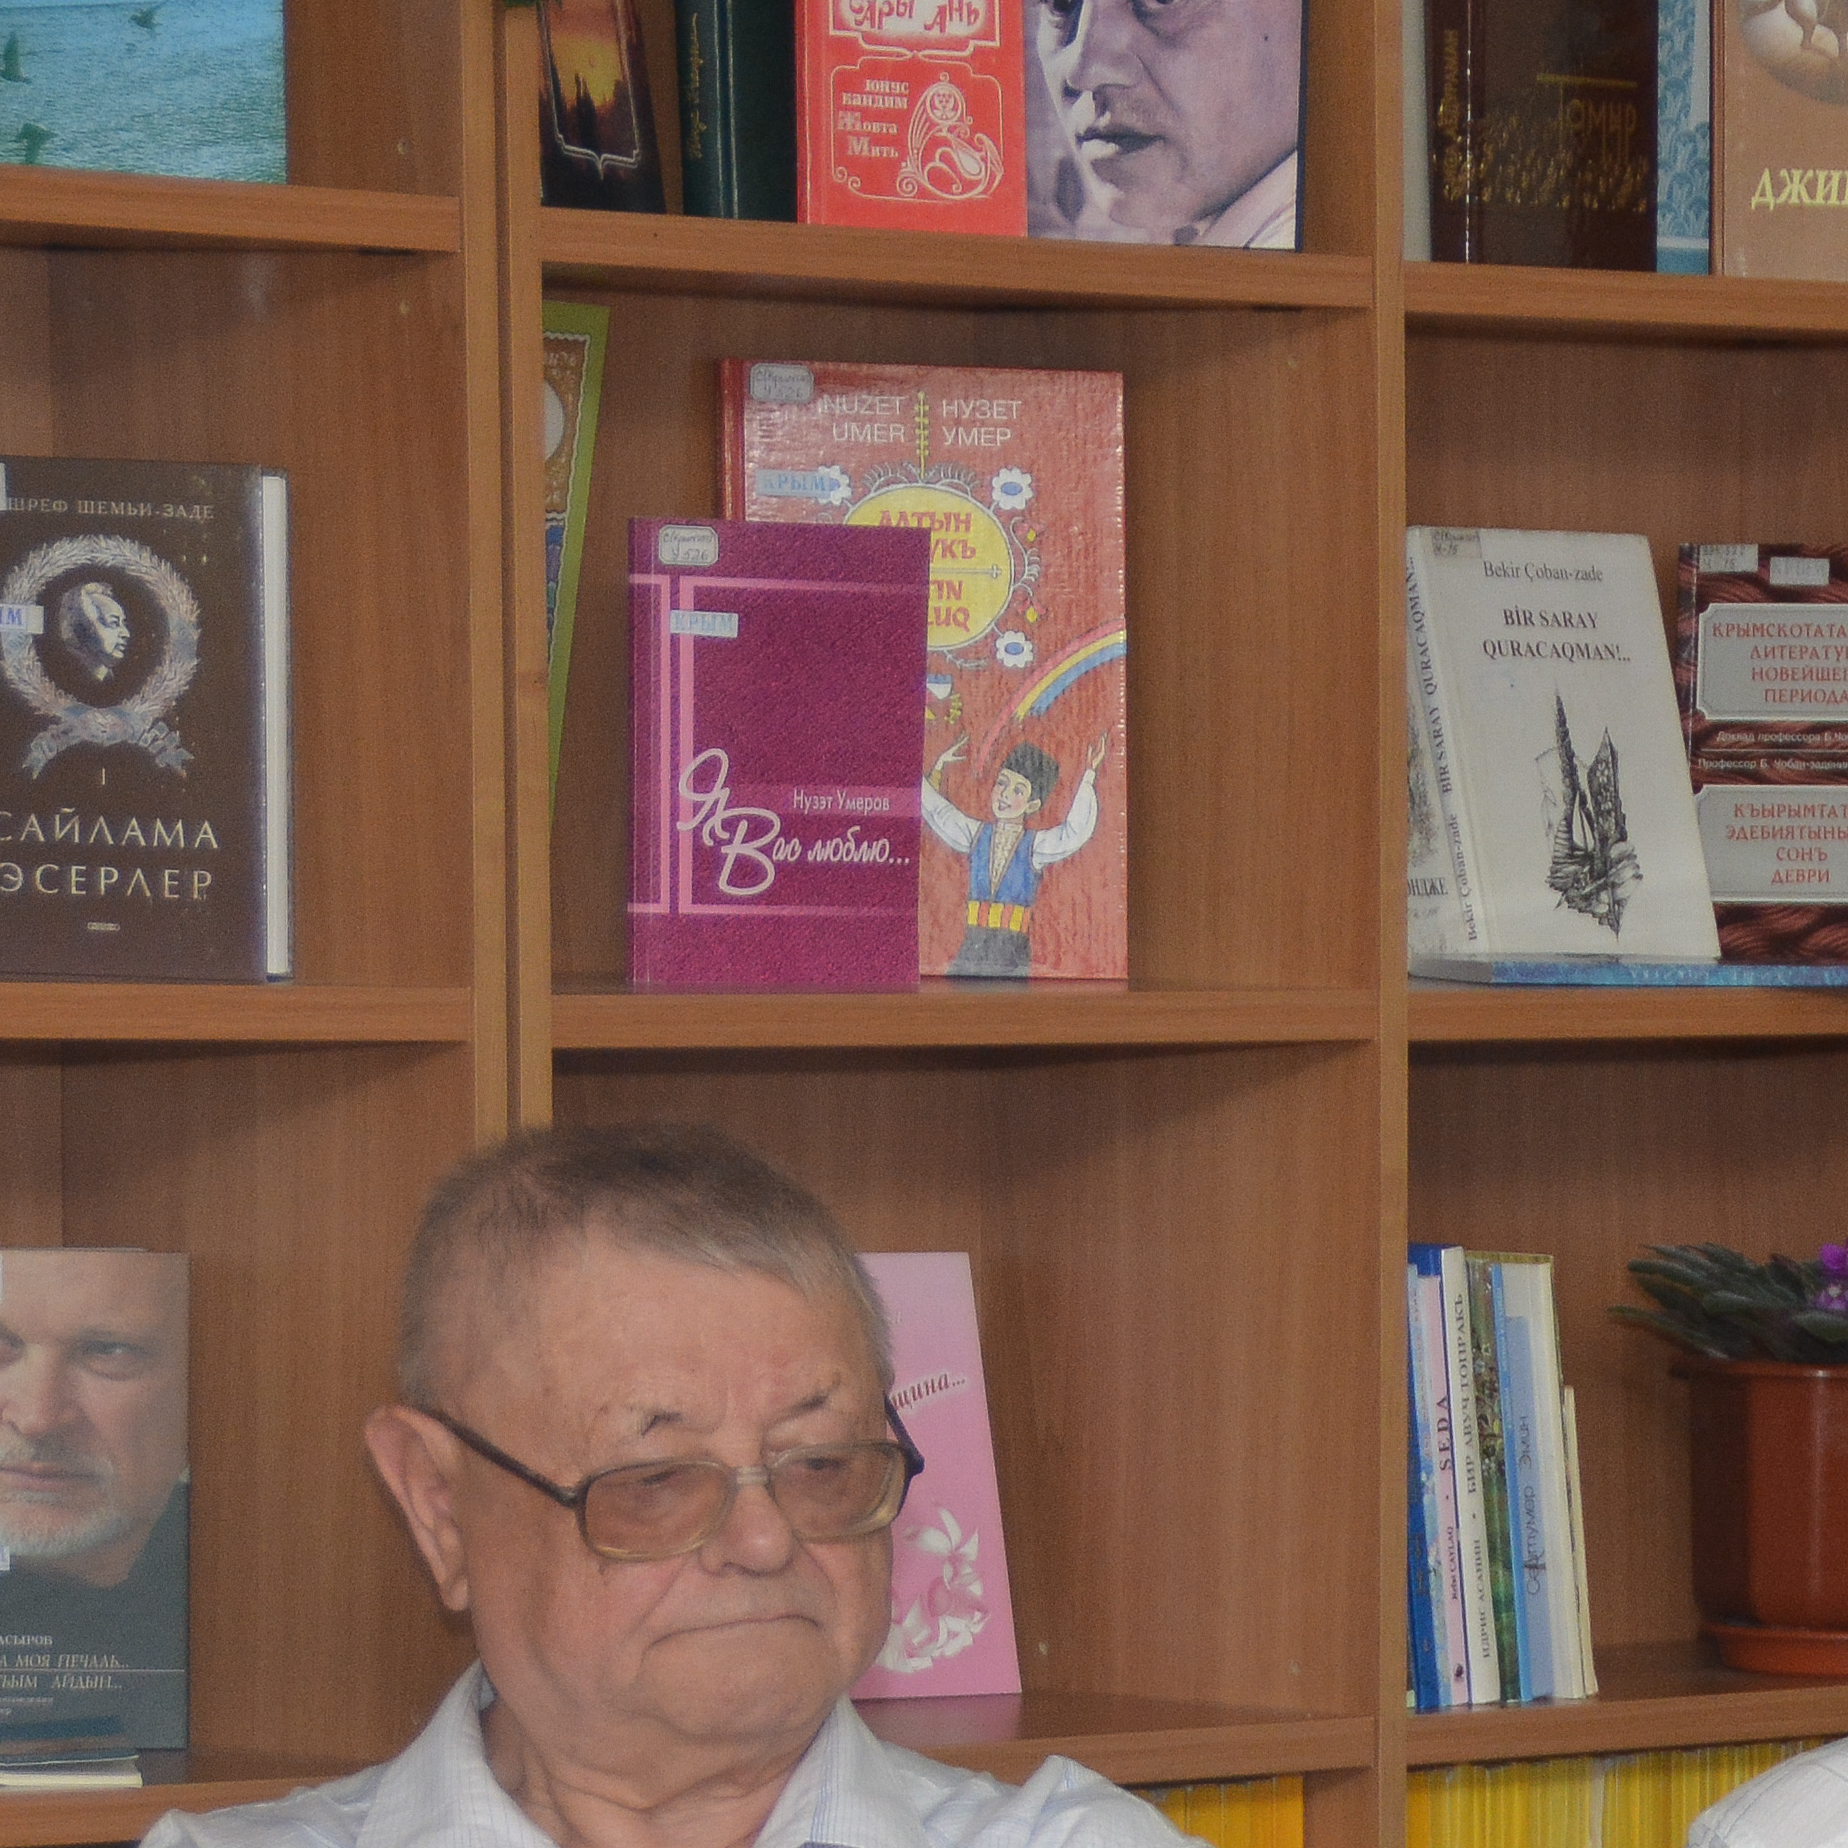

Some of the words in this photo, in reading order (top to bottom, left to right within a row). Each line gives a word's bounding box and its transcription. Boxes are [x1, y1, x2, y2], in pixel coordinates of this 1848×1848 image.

[942, 399, 1022, 420] НУЗЕТ
[832, 422, 905, 443] UMER
[942, 427, 1012, 447] УМЕР
[1483, 561, 1521, 578] Bekir
[1524, 563, 1603, 583] Çoban-zade
[1503, 605, 1536, 626] BİR
[1540, 611, 1598, 630] SARAY
[676, 748, 731, 840] Я
[793, 788, 833, 814] Нузэт
[837, 789, 890, 815] Умеров
[1776, 847, 1828, 862] СОНЪ
[0, 862, 213, 900] ЭСЕРЛЕР
[1771, 869, 1830, 885] ДЕВРИ
[891, 1373, 966, 1410] щина...
[1436, 1393, 1452, 1471] SEDA
